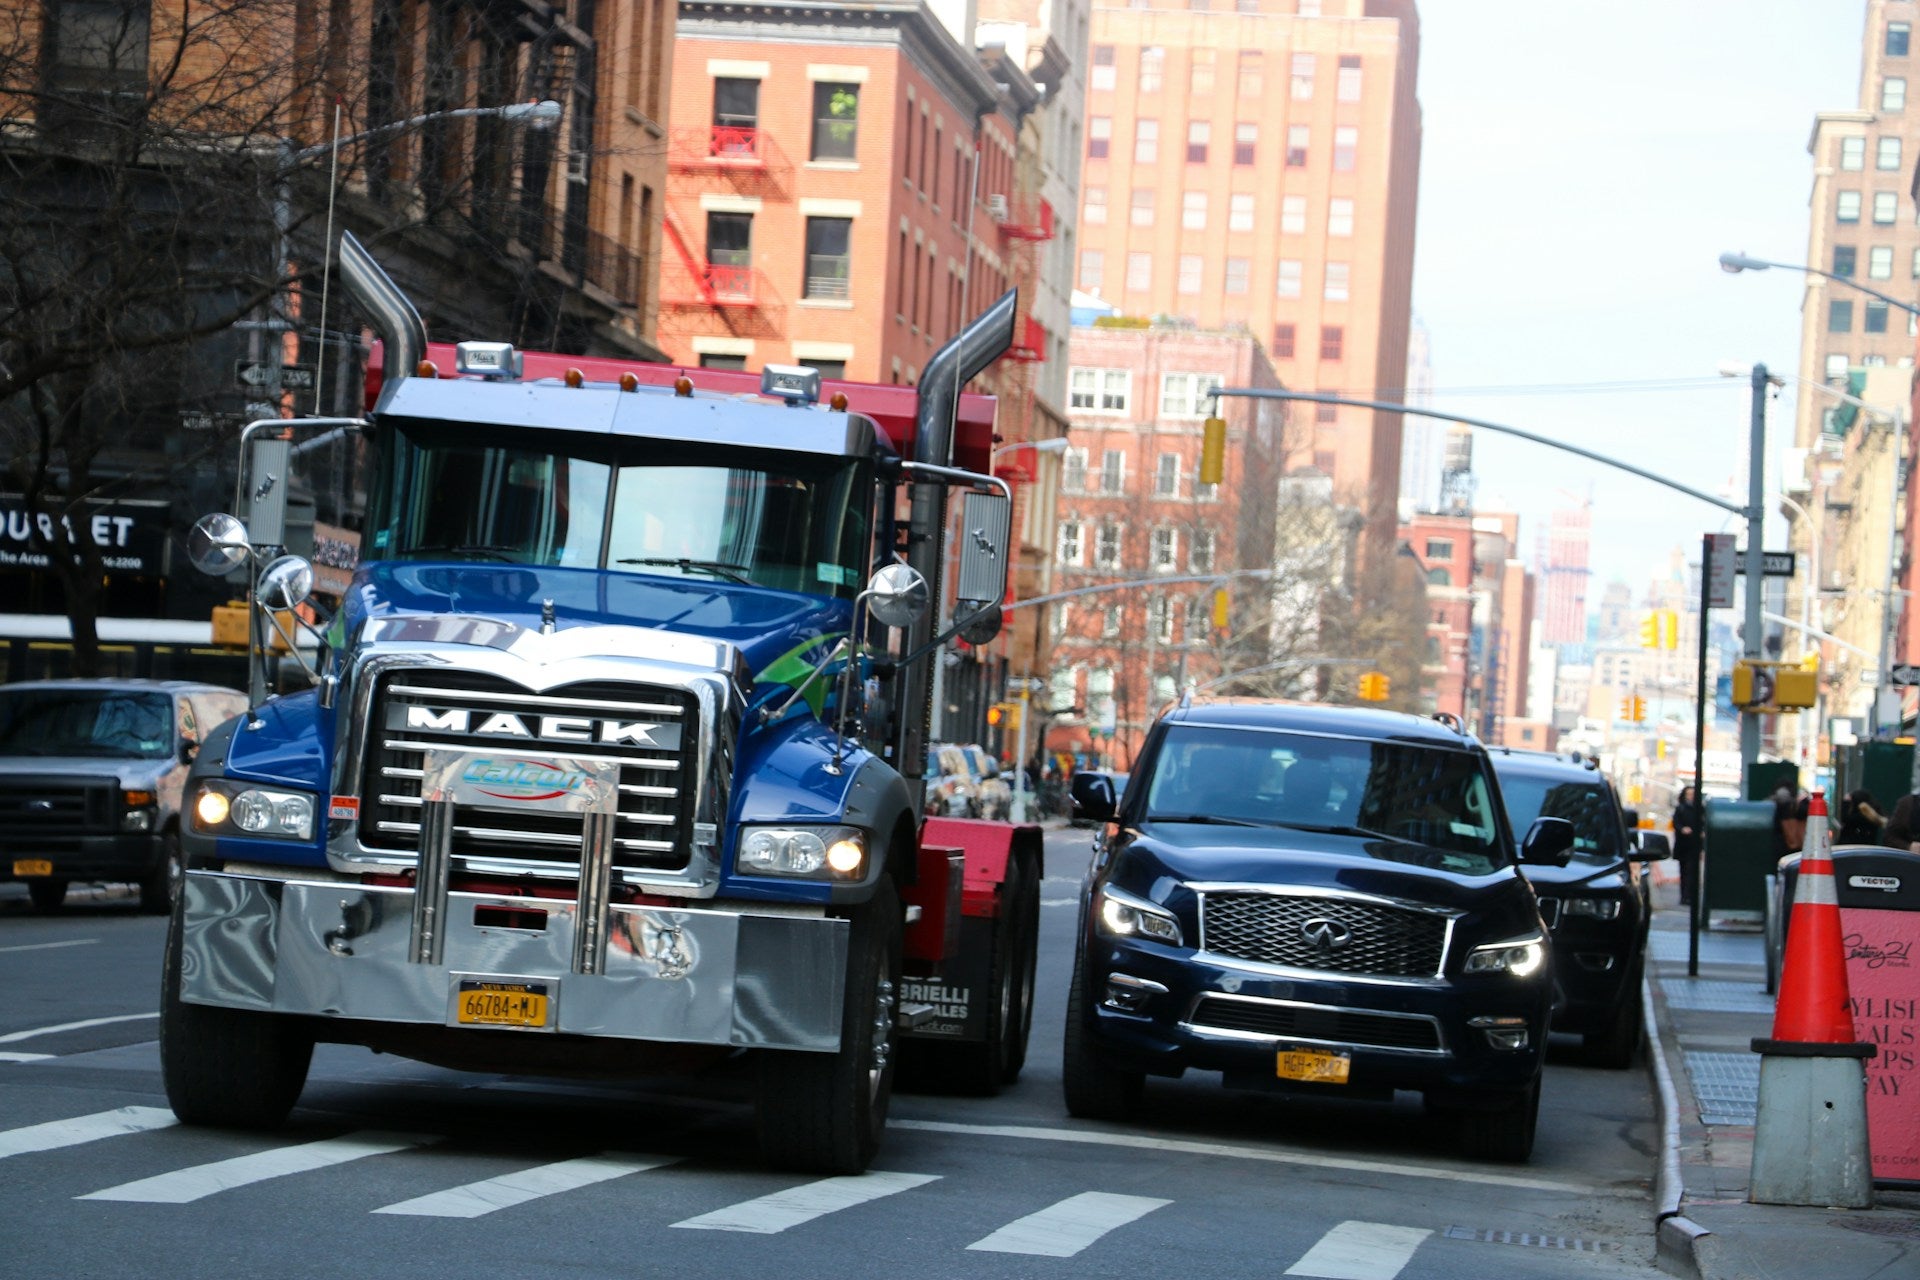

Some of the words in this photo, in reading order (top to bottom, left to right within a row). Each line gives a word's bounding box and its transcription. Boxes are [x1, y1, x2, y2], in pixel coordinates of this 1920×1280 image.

[0, 510, 134, 547] URET
[406, 706, 660, 747] MACK
[1861, 877, 1896, 885] VECTOR
[932, 1003, 968, 1019] ALES
